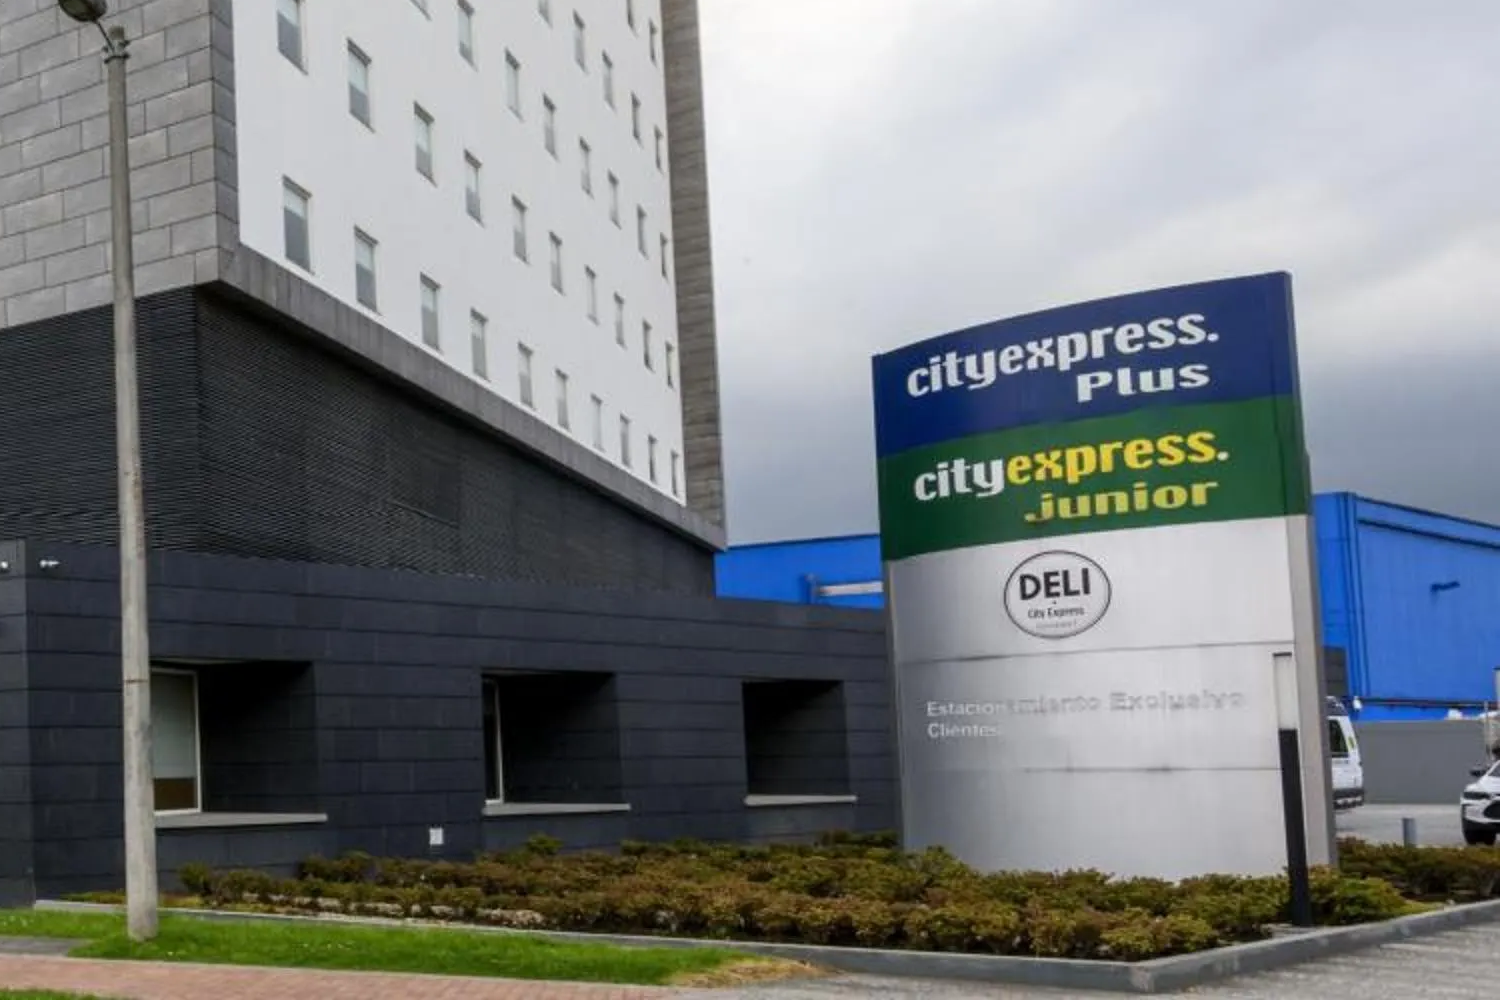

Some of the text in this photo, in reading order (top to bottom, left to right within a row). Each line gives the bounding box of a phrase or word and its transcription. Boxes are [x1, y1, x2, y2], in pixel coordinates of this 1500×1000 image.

[1076, 362, 1211, 403] Plus
[1024, 480, 1220, 523] junior
[1019, 567, 1091, 601] DELI
[926, 694, 1100, 717] Estacionmiento
